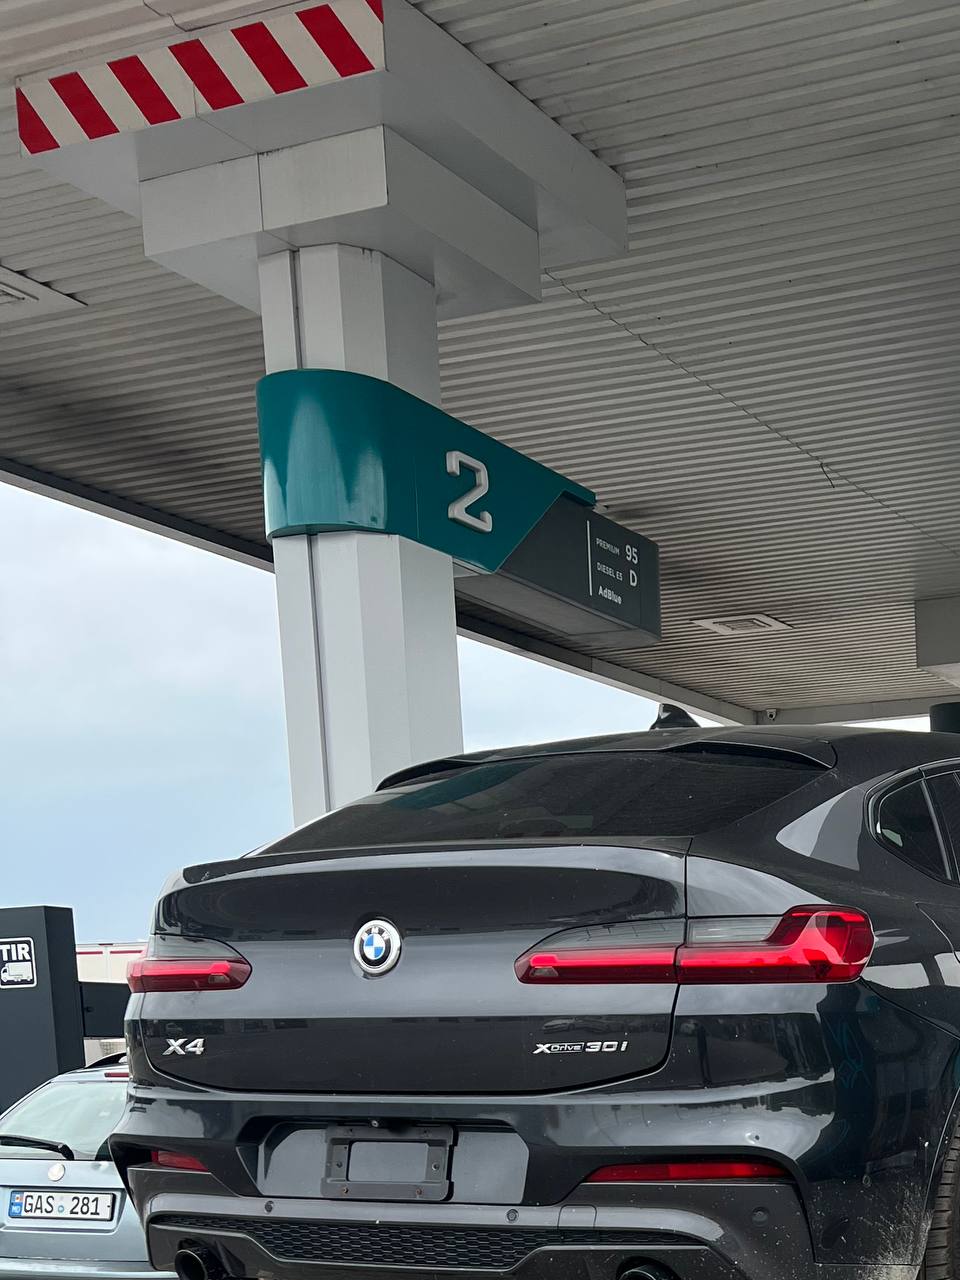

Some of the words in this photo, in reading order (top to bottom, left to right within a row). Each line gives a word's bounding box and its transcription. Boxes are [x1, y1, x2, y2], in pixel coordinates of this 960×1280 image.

[446, 450, 492, 533] 2
[595, 537, 620, 556] PREMIUM
[625, 544, 638, 564] 95
[597, 562, 616, 578] DIESEL
[629, 569, 638, 587] D
[598, 585, 622, 605] AdBlue
[0, 943, 31, 961] TIR
[162, 1037, 205, 1056] X4
[24, 1194, 55, 1214] GAS
[70, 1196, 100, 1216] 281
